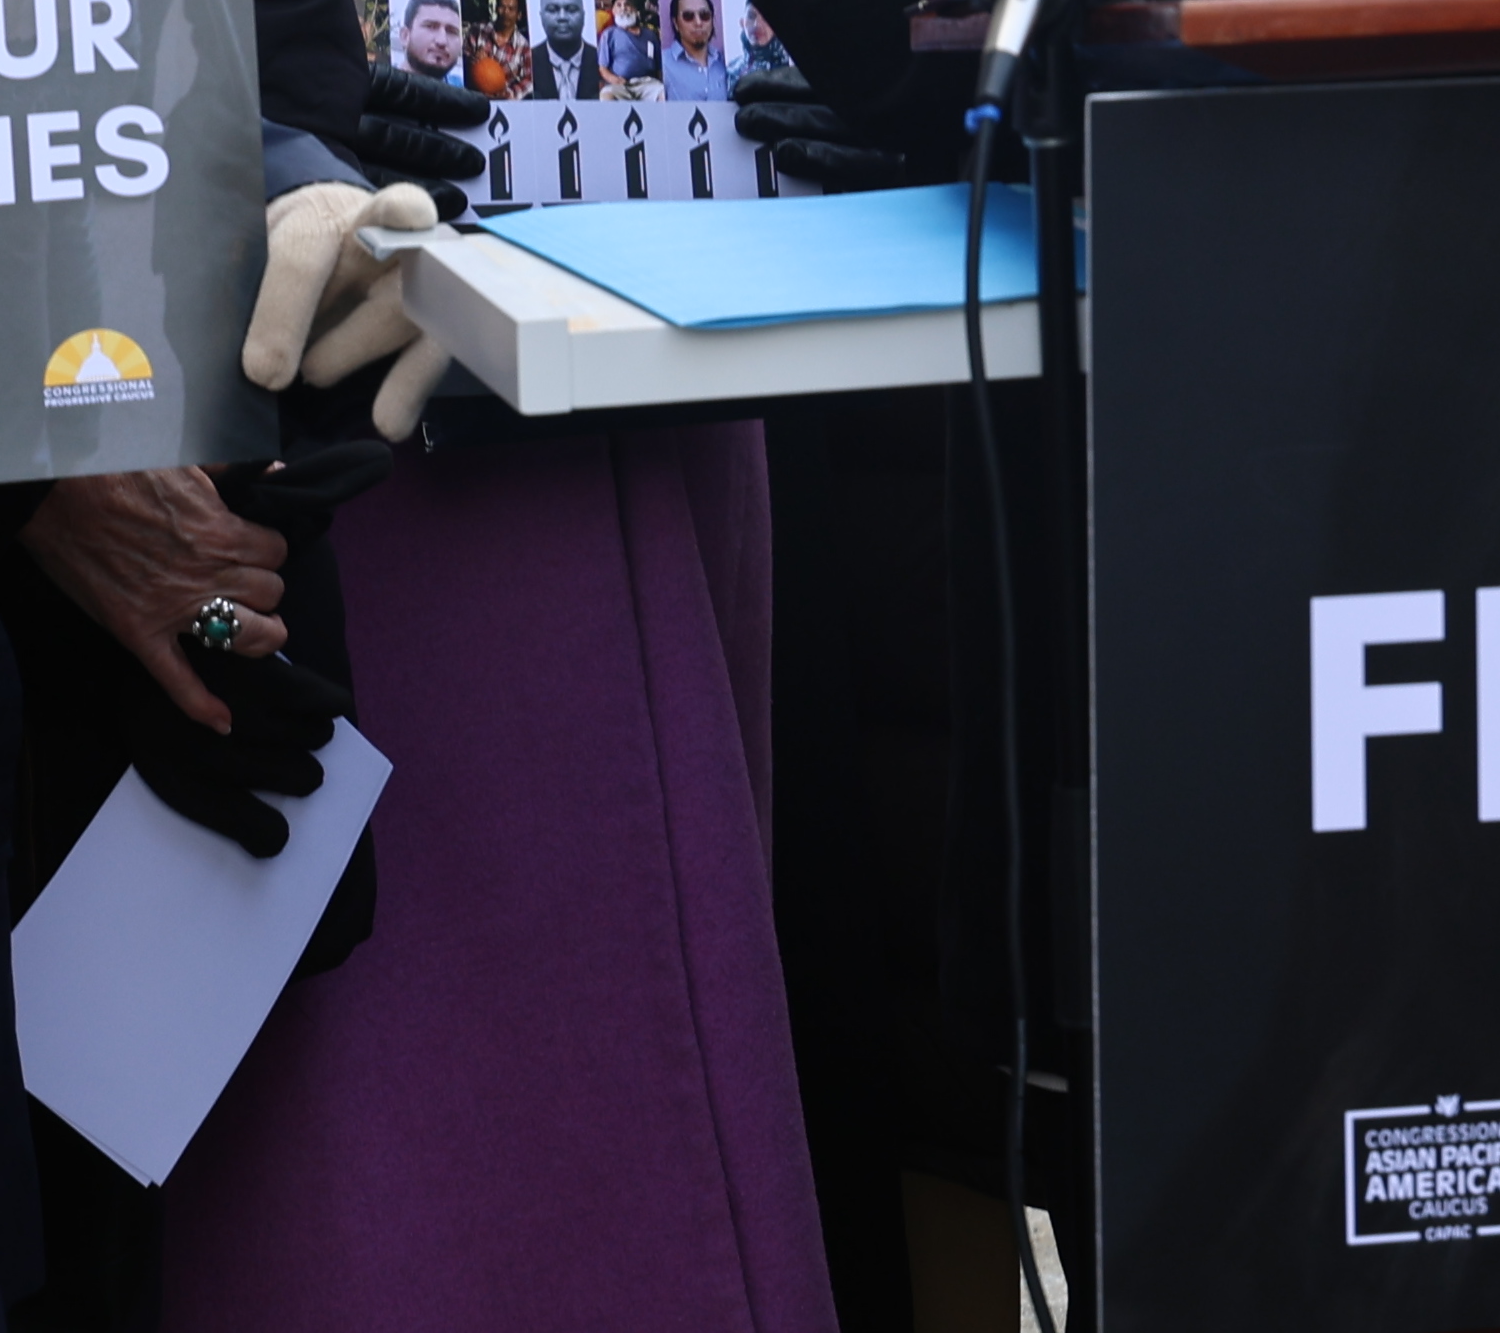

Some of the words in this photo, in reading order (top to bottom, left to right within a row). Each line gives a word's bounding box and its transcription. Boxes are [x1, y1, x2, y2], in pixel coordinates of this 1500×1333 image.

[43, 379, 154, 398] CONGRESSIONAL
[1365, 1146, 1438, 1175] ASIAN
[1408, 1196, 1489, 1219] CAUCUS
